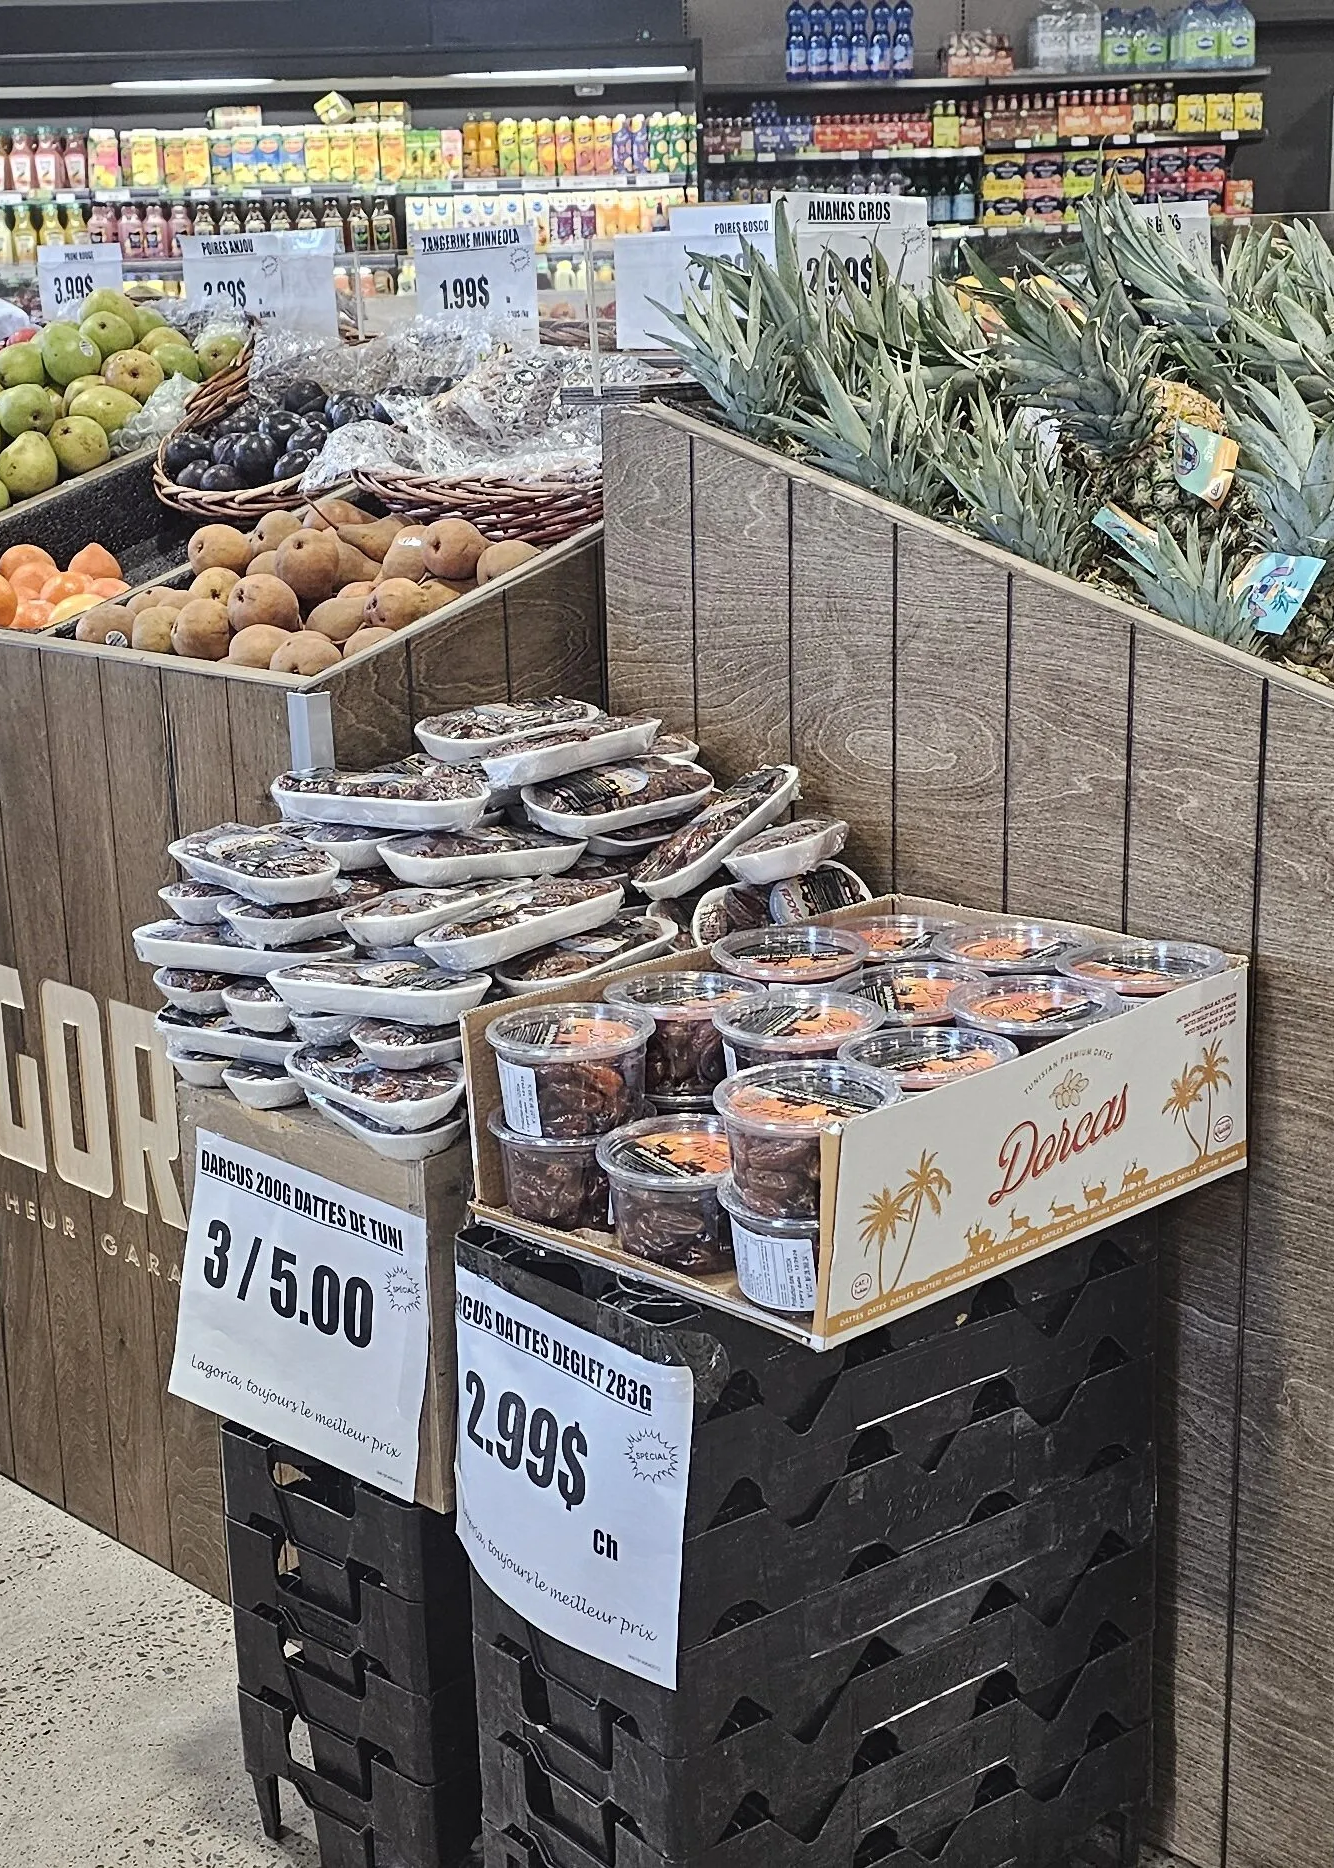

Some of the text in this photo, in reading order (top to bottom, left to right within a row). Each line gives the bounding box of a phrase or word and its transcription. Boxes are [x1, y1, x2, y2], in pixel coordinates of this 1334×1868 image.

[421, 228, 520, 253] TANGERINE MINNEOLA
[714, 220, 742, 235] POIRES
[808, 200, 891, 221] ANANAS GROS
[1154, 213, 1182, 233] GS
[201, 238, 254, 256] POIRES ANJOU
[439, 274, 490, 310] 1.99$
[1024, 1047, 1114, 1095] TUNISIAN PREMIUM DATES
[987, 1081, 1129, 1207] Dorcas
[200, 1149, 404, 1252] DARCUS 200G DATTES DE TUNI
[203, 1219, 375, 1349] 3 / 5.00
[840, 1312, 864, 1327] DATTES
[867, 1303, 887, 1316] DATES
[889, 1291, 914, 1306] DATILES
[997, 1246, 1019, 1261] DATTES
[495, 1311, 550, 1360] DATTES
[552, 1339, 605, 1388] DEGLET
[605, 1368, 653, 1412] 283G
[190, 1353, 402, 1459] Lagoria, toujours le meilleur prix
[465, 1369, 588, 1512] 2.99$
[592, 1528, 619, 1562] Ch
[487, 1538, 534, 1584] toujours
[534, 1571, 549, 1592] le
[550, 1585, 618, 1625] meilleur
[619, 1615, 659, 1642] prix
